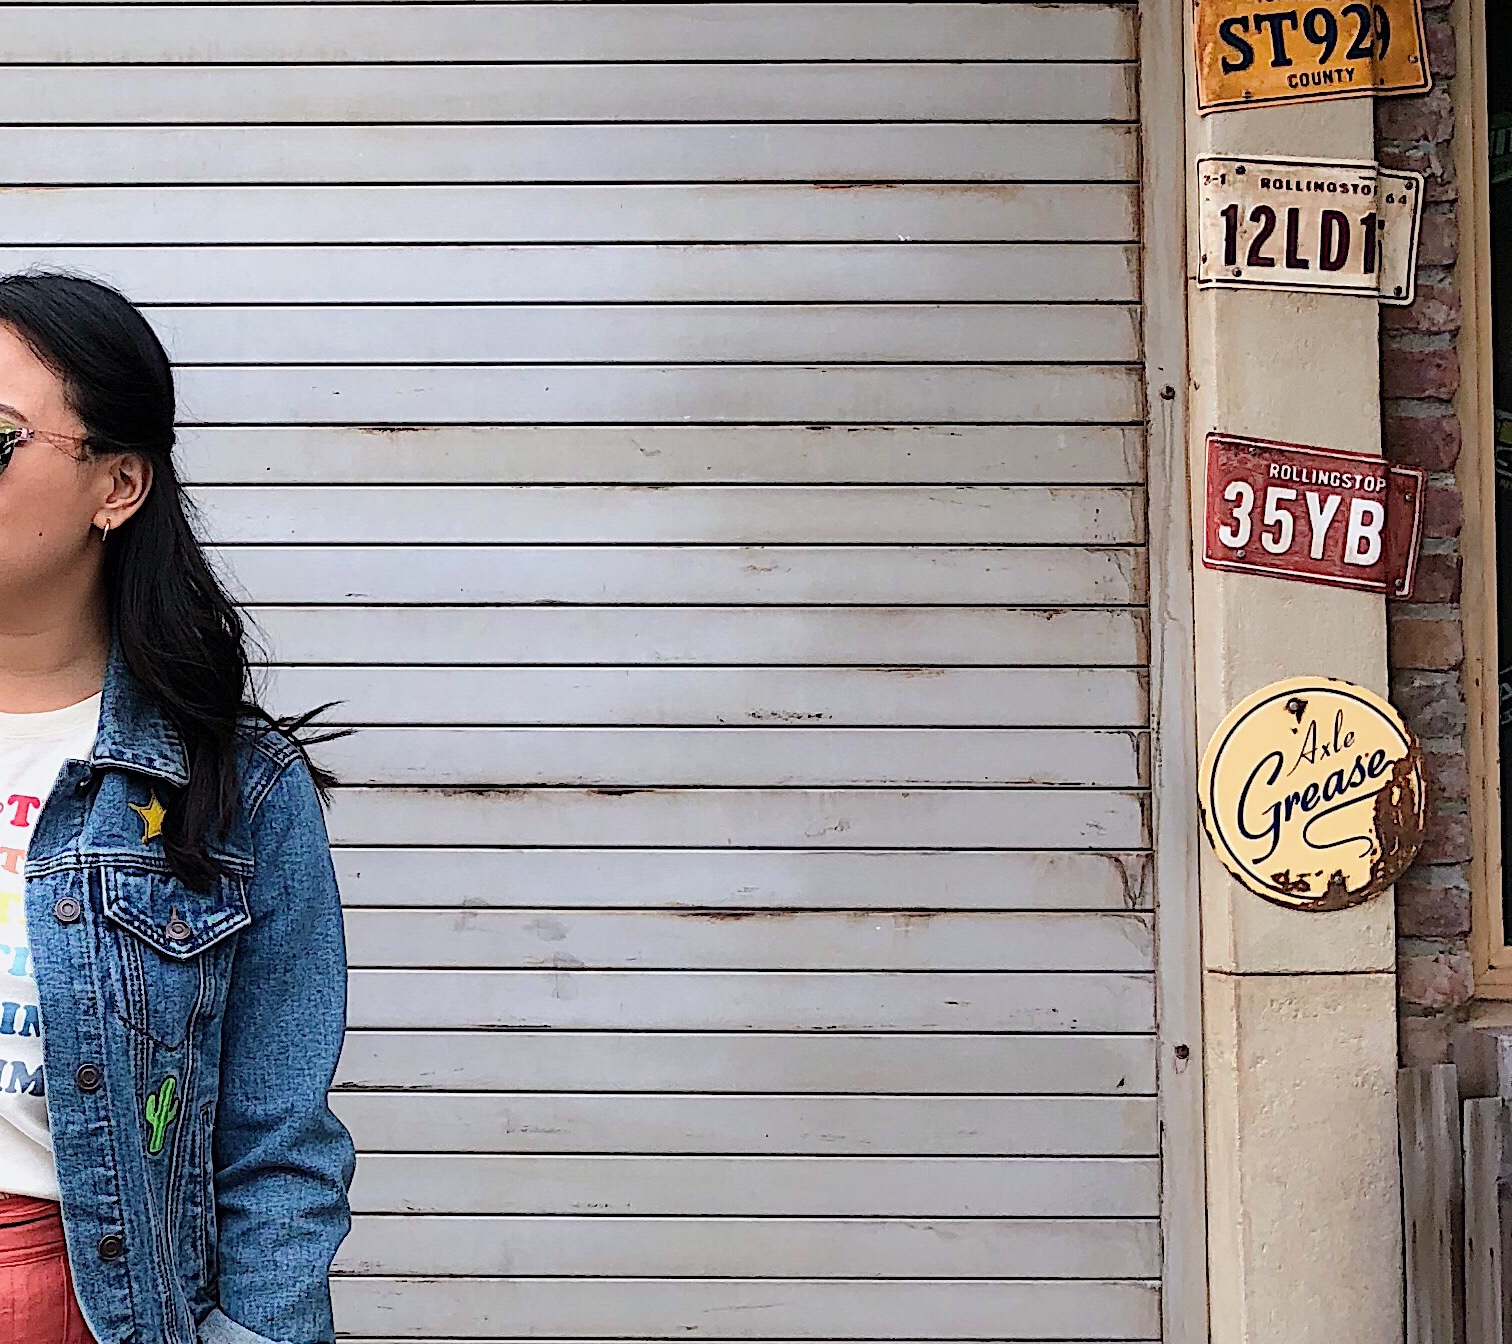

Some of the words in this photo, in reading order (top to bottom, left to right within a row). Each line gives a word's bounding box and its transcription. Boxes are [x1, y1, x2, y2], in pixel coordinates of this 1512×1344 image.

[1288, 68, 1355, 89] COUNTY
[1220, 203, 1385, 275] 12LD1
[1269, 463, 1387, 493] ROLLINGSTOP
[1218, 480, 1385, 566] 35YB
[1287, 709, 1355, 777] Axle
[1238, 749, 1390, 865] Grease
